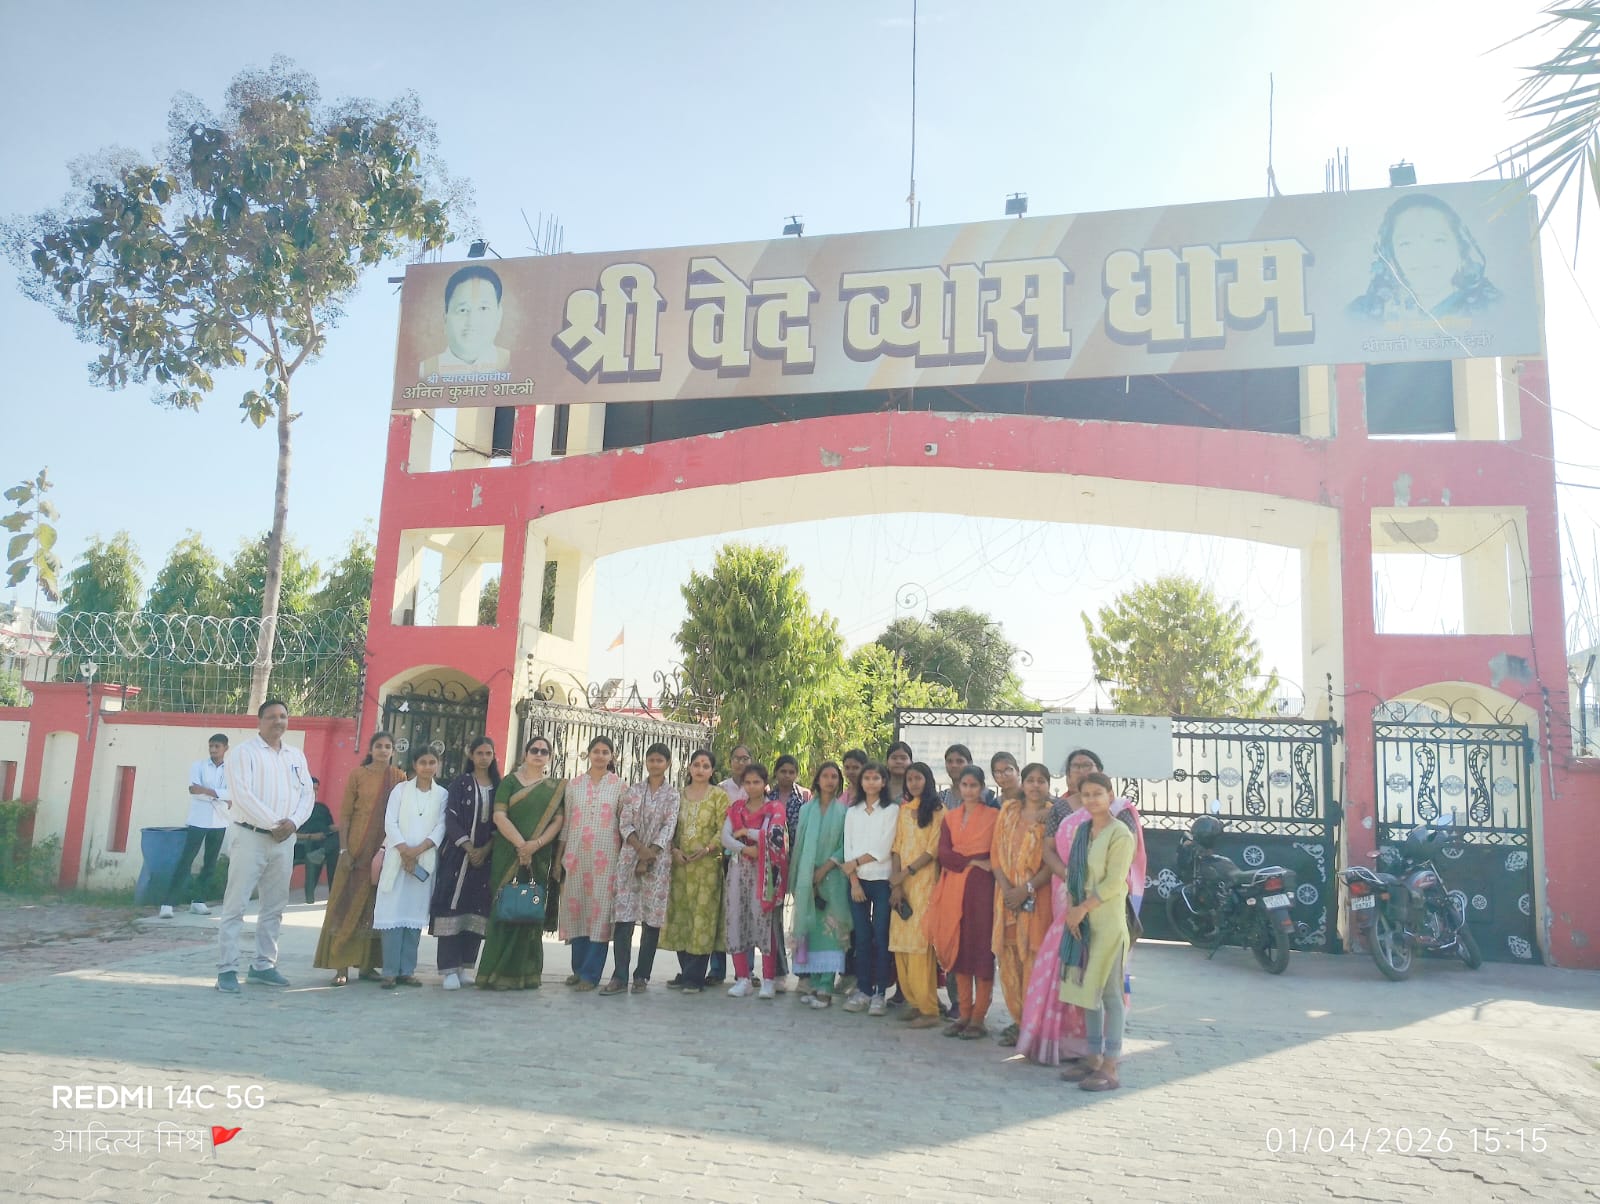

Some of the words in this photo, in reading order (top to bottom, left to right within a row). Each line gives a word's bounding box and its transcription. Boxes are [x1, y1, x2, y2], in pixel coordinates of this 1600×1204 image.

[552, 261, 668, 384] श्री
[685, 255, 819, 378] वेद
[839, 255, 1075, 367] व्यास
[1103, 237, 1315, 353] धाम
[427, 371, 439, 384] श्री
[402, 382, 444, 399] अनिल
[448, 384, 489, 404] कुमार
[493, 378, 535, 397] शास्त्री
[1045, 718, 1061, 726] आप
[1084, 717, 1094, 728] की
[1096, 717, 1127, 729] निगरानी
